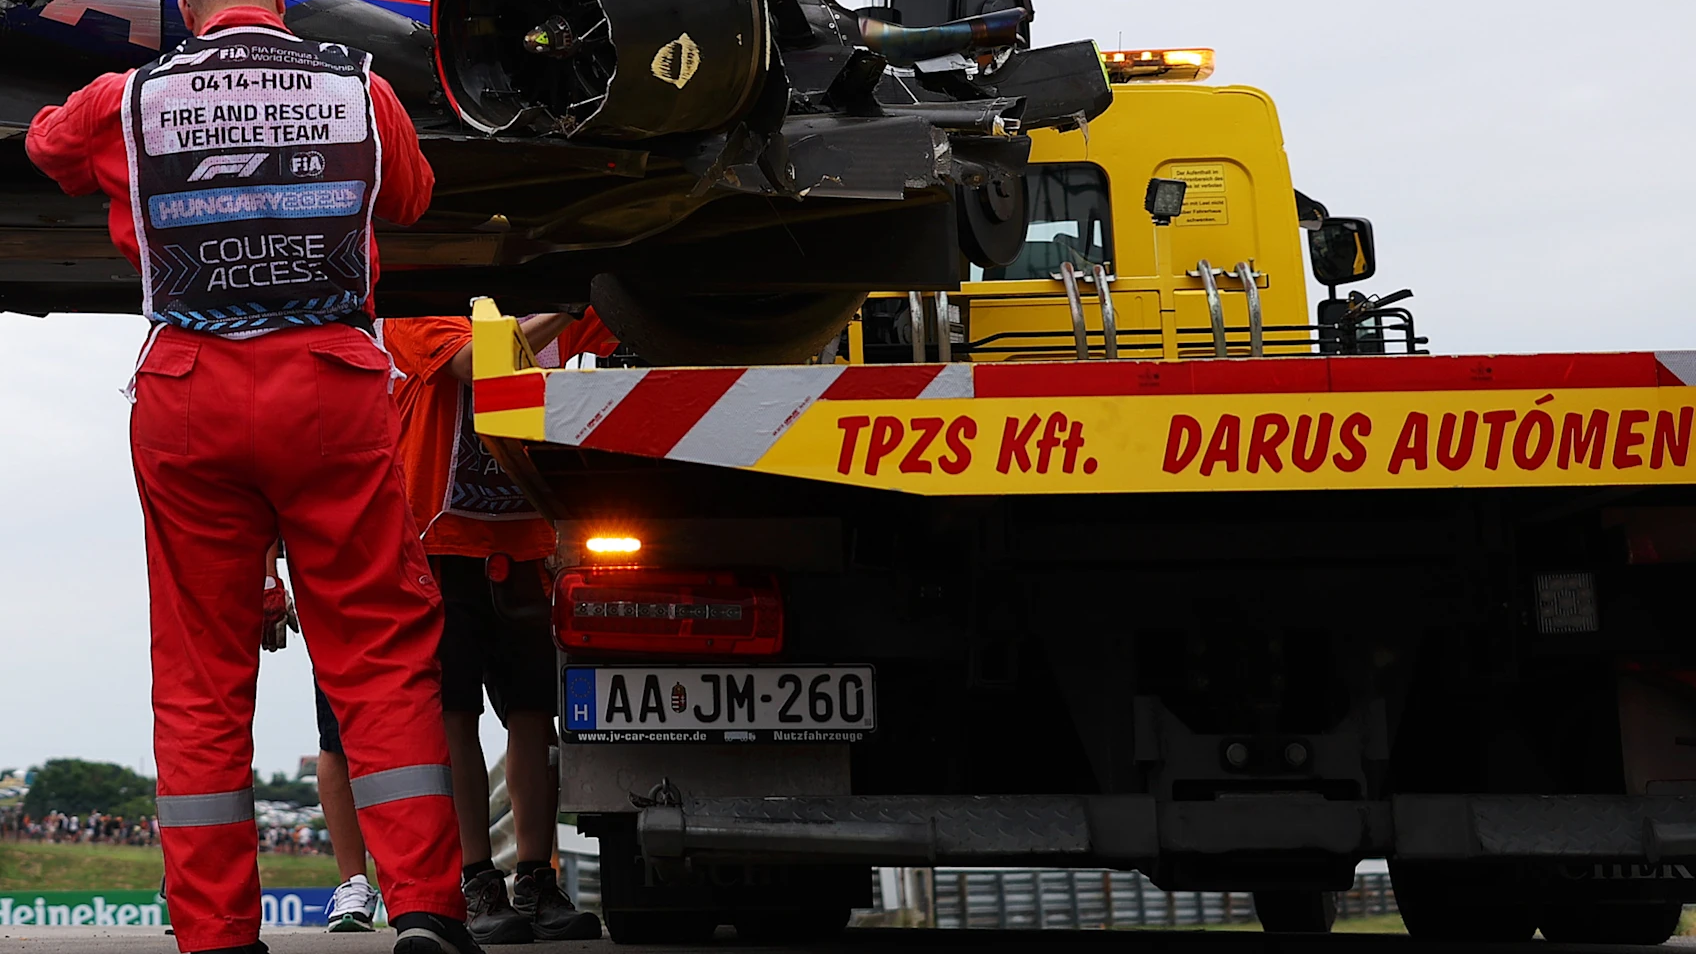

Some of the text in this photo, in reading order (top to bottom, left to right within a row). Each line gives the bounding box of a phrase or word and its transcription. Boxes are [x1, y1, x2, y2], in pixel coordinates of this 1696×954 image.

[251, 53, 354, 72] World Championship
[270, 47, 312, 60] Formula
[191, 72, 313, 92] 0414-HUN
[160, 104, 347, 128] FIRE AND RESCUE
[177, 124, 330, 148] VEHICLE TEAM
[290, 154, 325, 175] FIA
[199, 234, 325, 264] COURSE
[206, 260, 329, 292] ACCESS
[836, 413, 978, 476] TPZS
[995, 410, 1099, 475] Kft.
[1161, 410, 1372, 477] DARUS
[1387, 393, 1695, 476] AUTÓMEN
[574, 673, 865, 724] H AA JM-260
[577, 730, 864, 743] www.jv-car-center.de Nutzfahrzeuge
